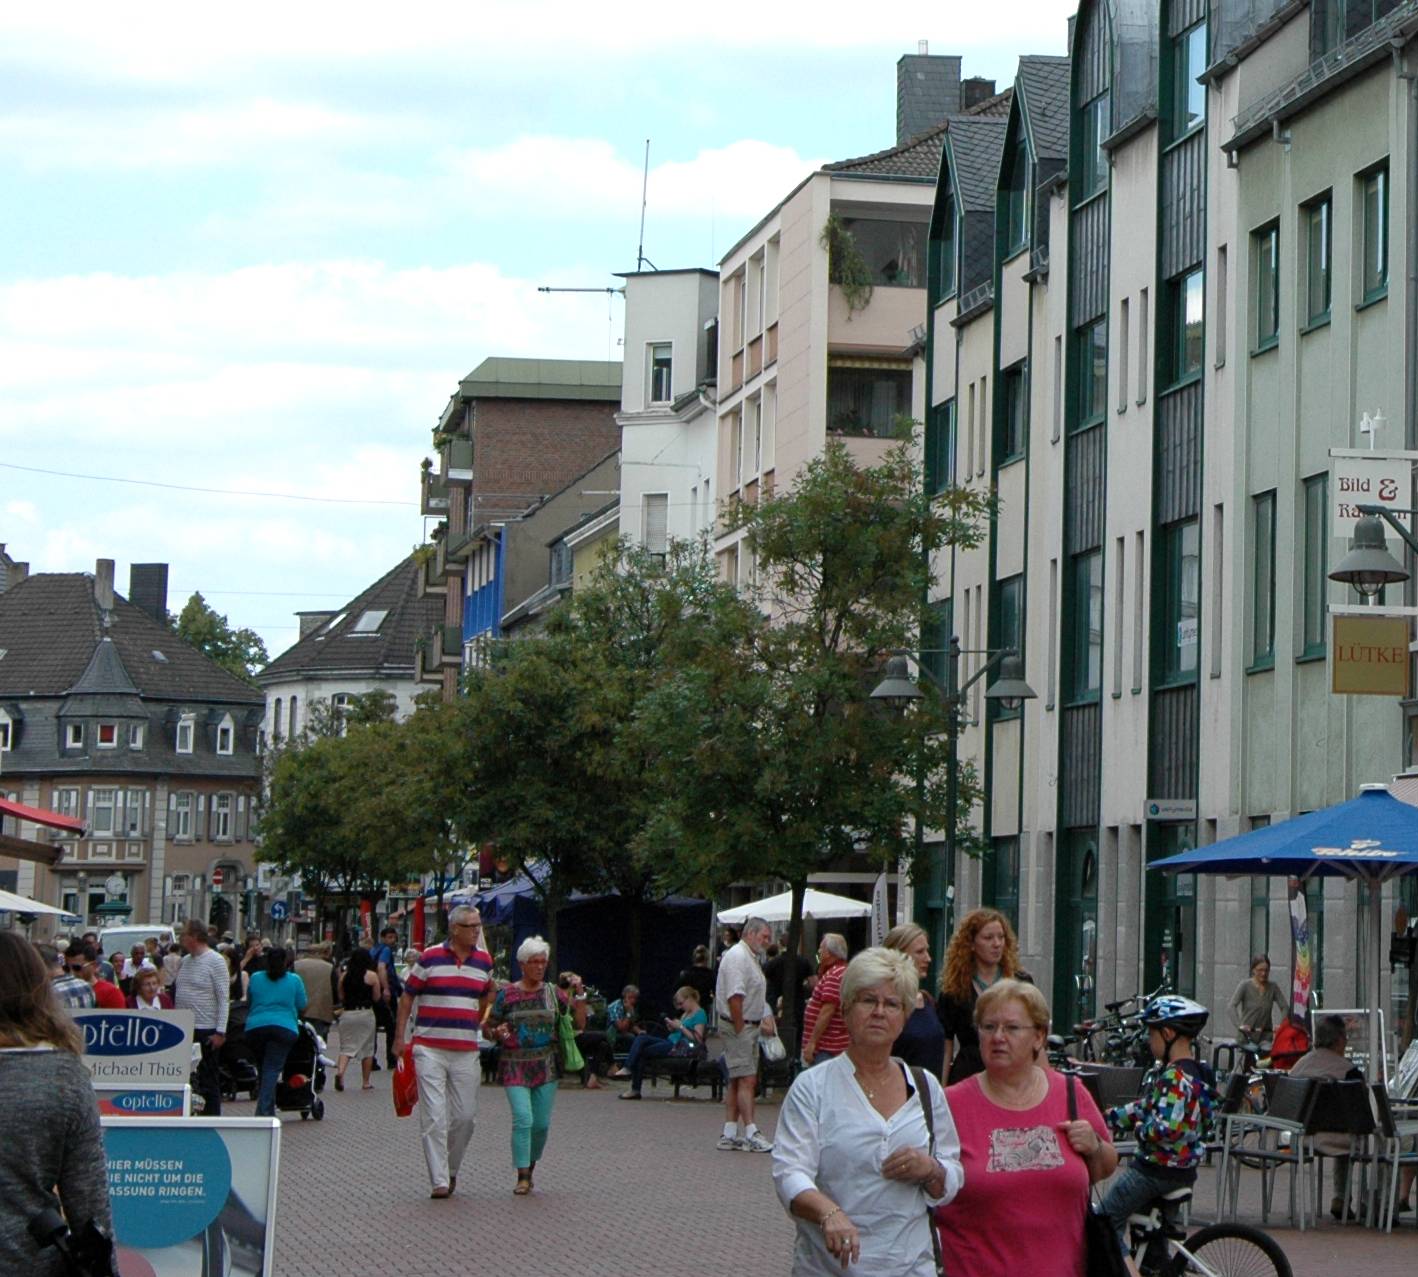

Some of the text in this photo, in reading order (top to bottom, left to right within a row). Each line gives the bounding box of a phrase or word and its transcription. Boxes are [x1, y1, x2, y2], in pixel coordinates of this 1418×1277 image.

[1338, 477, 1398, 501] Bild &
[1338, 642, 1404, 664] LÜTKE
[83, 1018, 160, 1047] ptello
[148, 1062, 182, 1077] Thüs
[122, 1094, 172, 1111] optello
[105, 1158, 184, 1170] HIER MÜSSEN
[107, 1173, 204, 1183] IE NICHT UM DIE
[108, 1186, 206, 1197] ASSUNG RINGEN.
